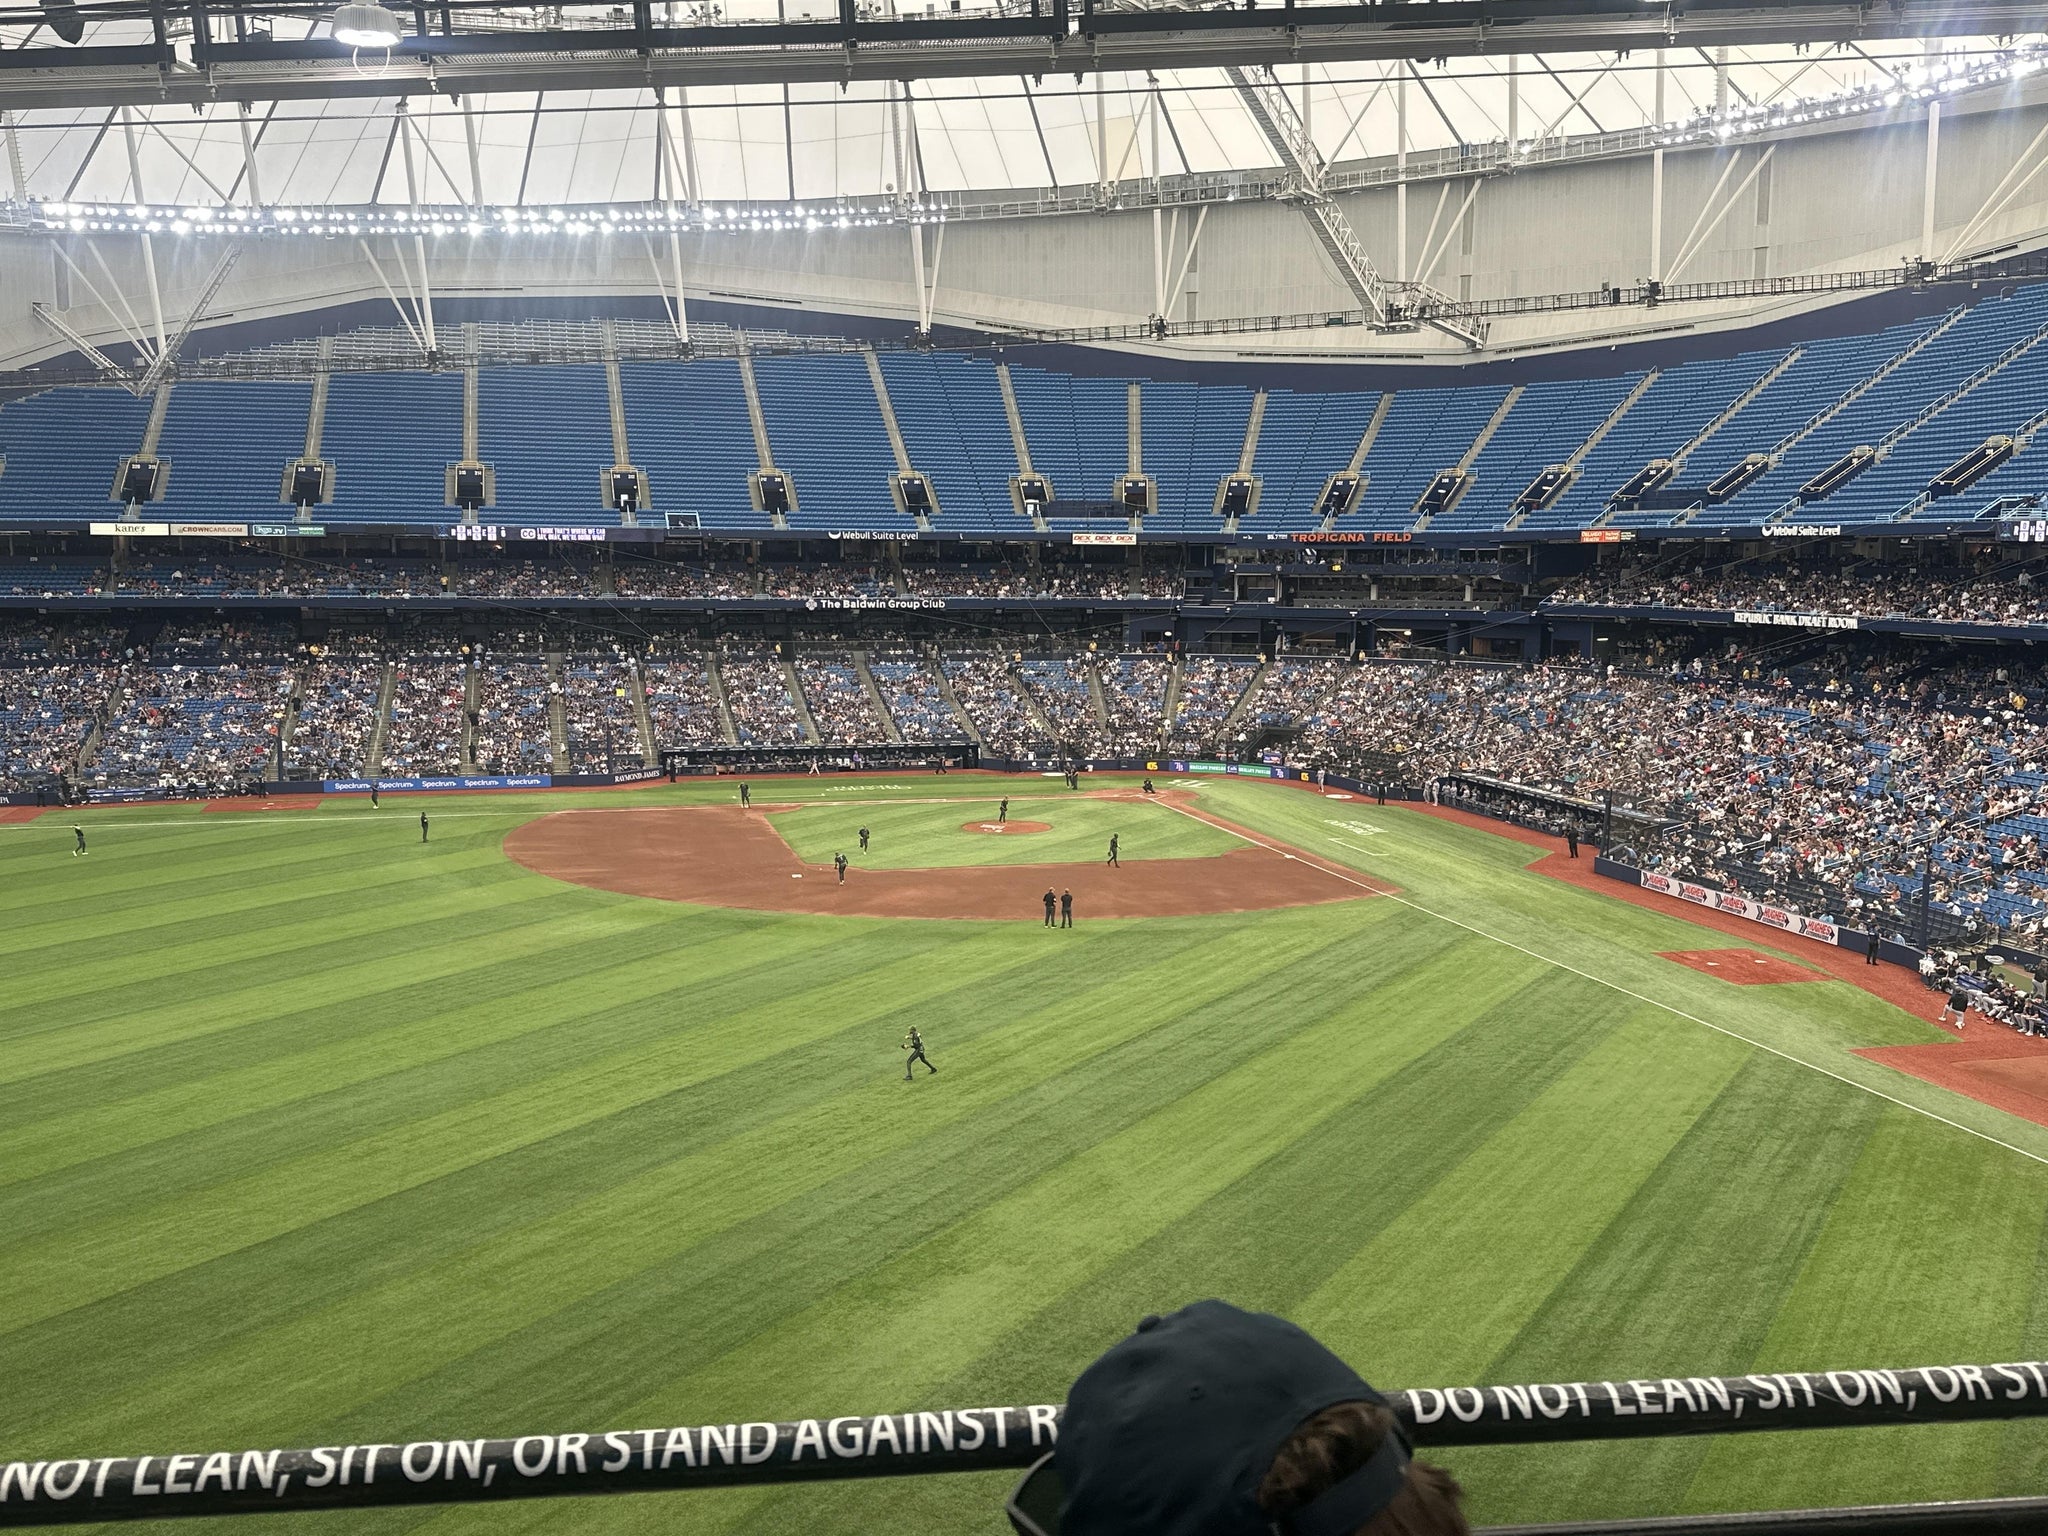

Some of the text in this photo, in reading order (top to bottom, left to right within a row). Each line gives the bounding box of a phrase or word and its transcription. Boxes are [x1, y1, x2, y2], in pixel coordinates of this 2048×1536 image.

[842, 531, 919, 540] Webull Suite Level
[1773, 525, 1841, 536] Webull Suite Level
[1291, 533, 1365, 543] TROPICANA
[1373, 533, 1412, 542] FIELD
[820, 600, 945, 610] The Baldwin Group Club
[1734, 612, 1858, 629] REPUBLIC BANK DRAFT ROOM
[507, 778, 538, 786] Spectrum
[614, 770, 660, 783] RAYMOND JAMES
[379, 781, 411, 789] Spectrum
[422, 780, 455, 788] Spectrum
[464, 779, 496, 788] Spectrum
[1649, 874, 1668, 887] HUGHES
[1685, 884, 1704, 898] HUGHES
[1723, 896, 1744, 910] HUGHES
[1764, 907, 1786, 922] HUGHES
[1808, 920, 1831, 935] HUGHES
[1405, 1387, 1485, 1424] DO
[1491, 1381, 1594, 1421] NOT
[1602, 1376, 1745, 1420] LEAN,
[1743, 1371, 1816, 1410] SIT
[1826, 1368, 1918, 1412] ON,
[1917, 1364, 1993, 1402] OR
[0, 1456, 128, 1502] NOT
[132, 1448, 291, 1498] LEAN,
[305, 1443, 394, 1488] SIT
[401, 1439, 498, 1488] ON,
[512, 1431, 590, 1478] OR
[602, 1420, 778, 1474] STAND
[791, 1405, 1015, 1462] AGAINST
